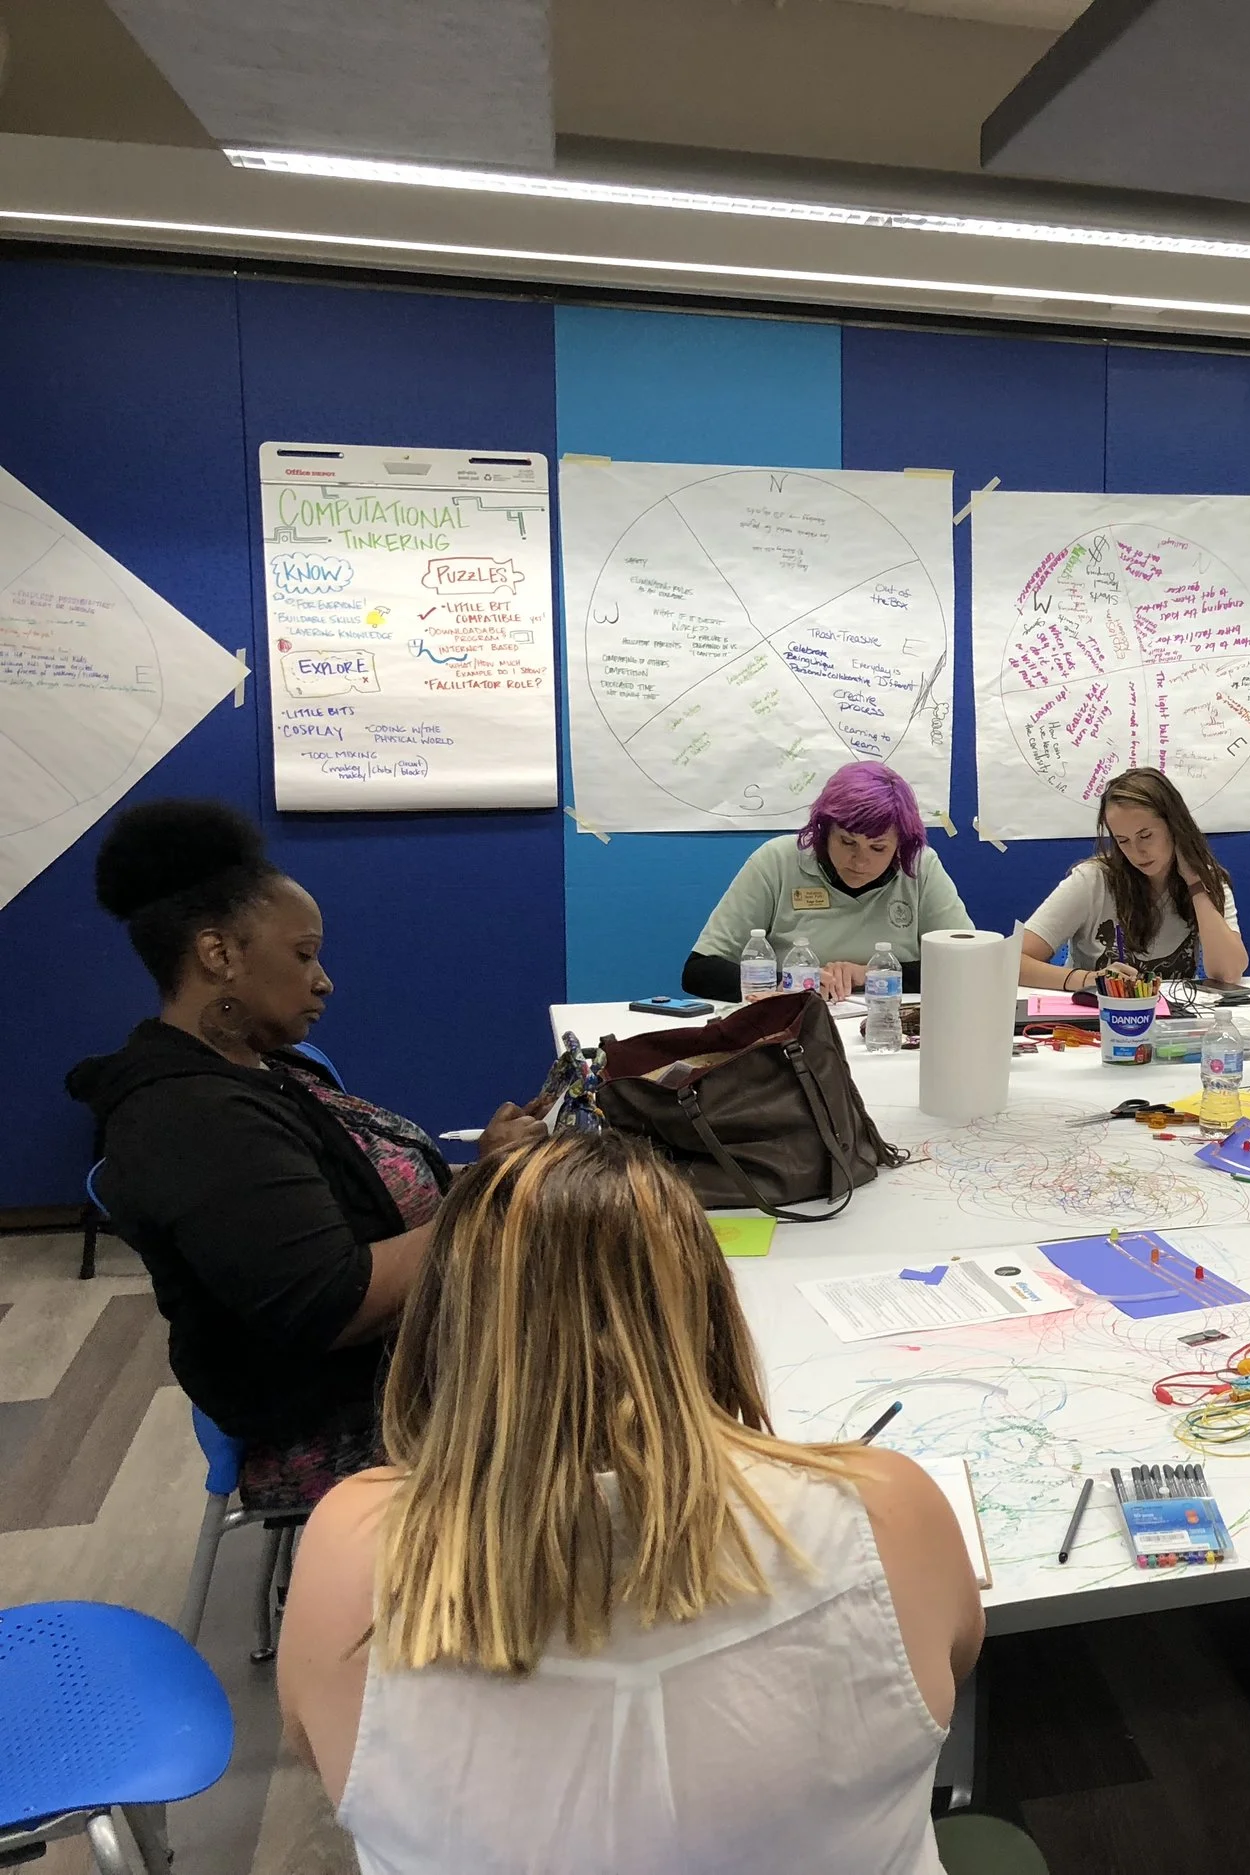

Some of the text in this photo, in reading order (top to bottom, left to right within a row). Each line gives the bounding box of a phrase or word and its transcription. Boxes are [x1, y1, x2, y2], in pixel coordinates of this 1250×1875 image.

[770, 474, 788, 493] N
[279, 488, 470, 529] COMPUTATIONAL
[338, 529, 450, 552] TINKERING
[283, 561, 342, 582] KNOW
[437, 565, 507, 584] PUZZLES
[875, 584, 912, 599] Out of
[1171, 594, 1196, 604] them
[1202, 586, 1215, 599] get
[1219, 588, 1228, 598] to
[447, 601, 511, 613] LITTLE BIT
[1032, 590, 1052, 614] W
[1202, 598, 1244, 614] engaging
[329, 615, 362, 624] SKILLS
[455, 614, 521, 624] COMPATIBLE
[593, 602, 620, 624] W
[1183, 608, 1198, 619] the
[428, 626, 507, 637] DOWNLOADABLE
[1048, 624, 1064, 649] When
[1216, 624, 1241, 636] better
[439, 643, 519, 654] INTERNET BASED
[902, 638, 927, 658] E
[1036, 632, 1050, 650] say
[1086, 635, 1106, 662] Time
[1204, 642, 1216, 652] be
[1220, 640, 1229, 650] to
[1029, 646, 1040, 656] do
[298, 659, 368, 675] EXPLORE
[852, 658, 892, 679] Everyday
[1008, 657, 1020, 668] do
[135, 666, 153, 684] E
[428, 678, 542, 690] FACILITATOR ROLE?
[285, 706, 356, 720] LITTLE BITS
[1030, 700, 1056, 724] Loosen
[1155, 695, 1170, 720] light
[283, 724, 344, 741] COSPLAY
[368, 724, 406, 734] CODING
[838, 720, 891, 742] Learning to
[1048, 721, 1062, 740] How
[1159, 724, 1170, 746] bulb
[374, 734, 454, 746] PHYSICAL WORLD
[850, 738, 880, 752] Learn
[1226, 736, 1248, 757] E
[305, 751, 378, 760] TOOL MIXING
[739, 784, 765, 811] S
[1112, 1014, 1150, 1024] DANNON
